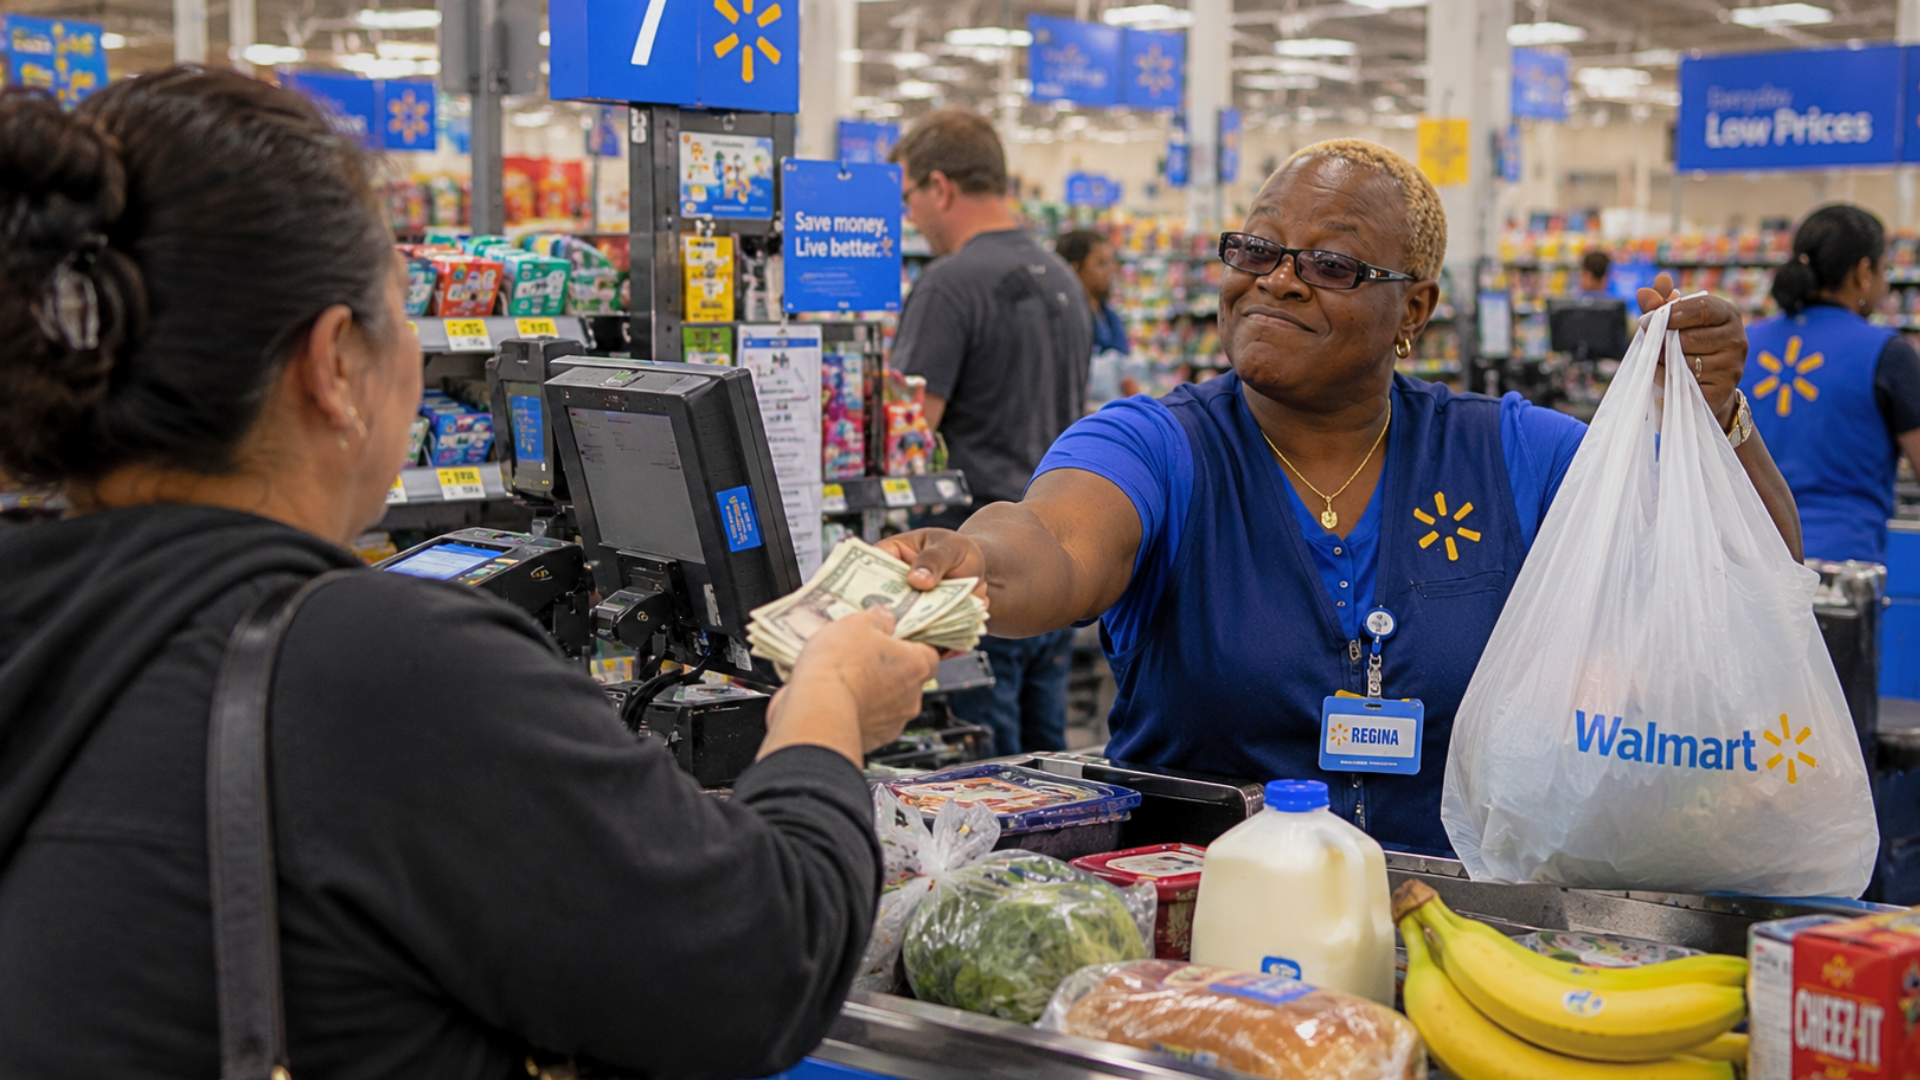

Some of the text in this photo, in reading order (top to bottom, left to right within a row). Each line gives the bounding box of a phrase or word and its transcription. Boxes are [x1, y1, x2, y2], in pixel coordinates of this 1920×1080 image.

[1705, 107, 1873, 148] Low Prices
[795, 211, 888, 238] Save money.
[795, 236, 882, 258] Live better.
[1351, 727, 1399, 746] REGINA
[1575, 709, 1758, 772] Walmart
[1795, 988, 1884, 1067] CHEEZ-IT
